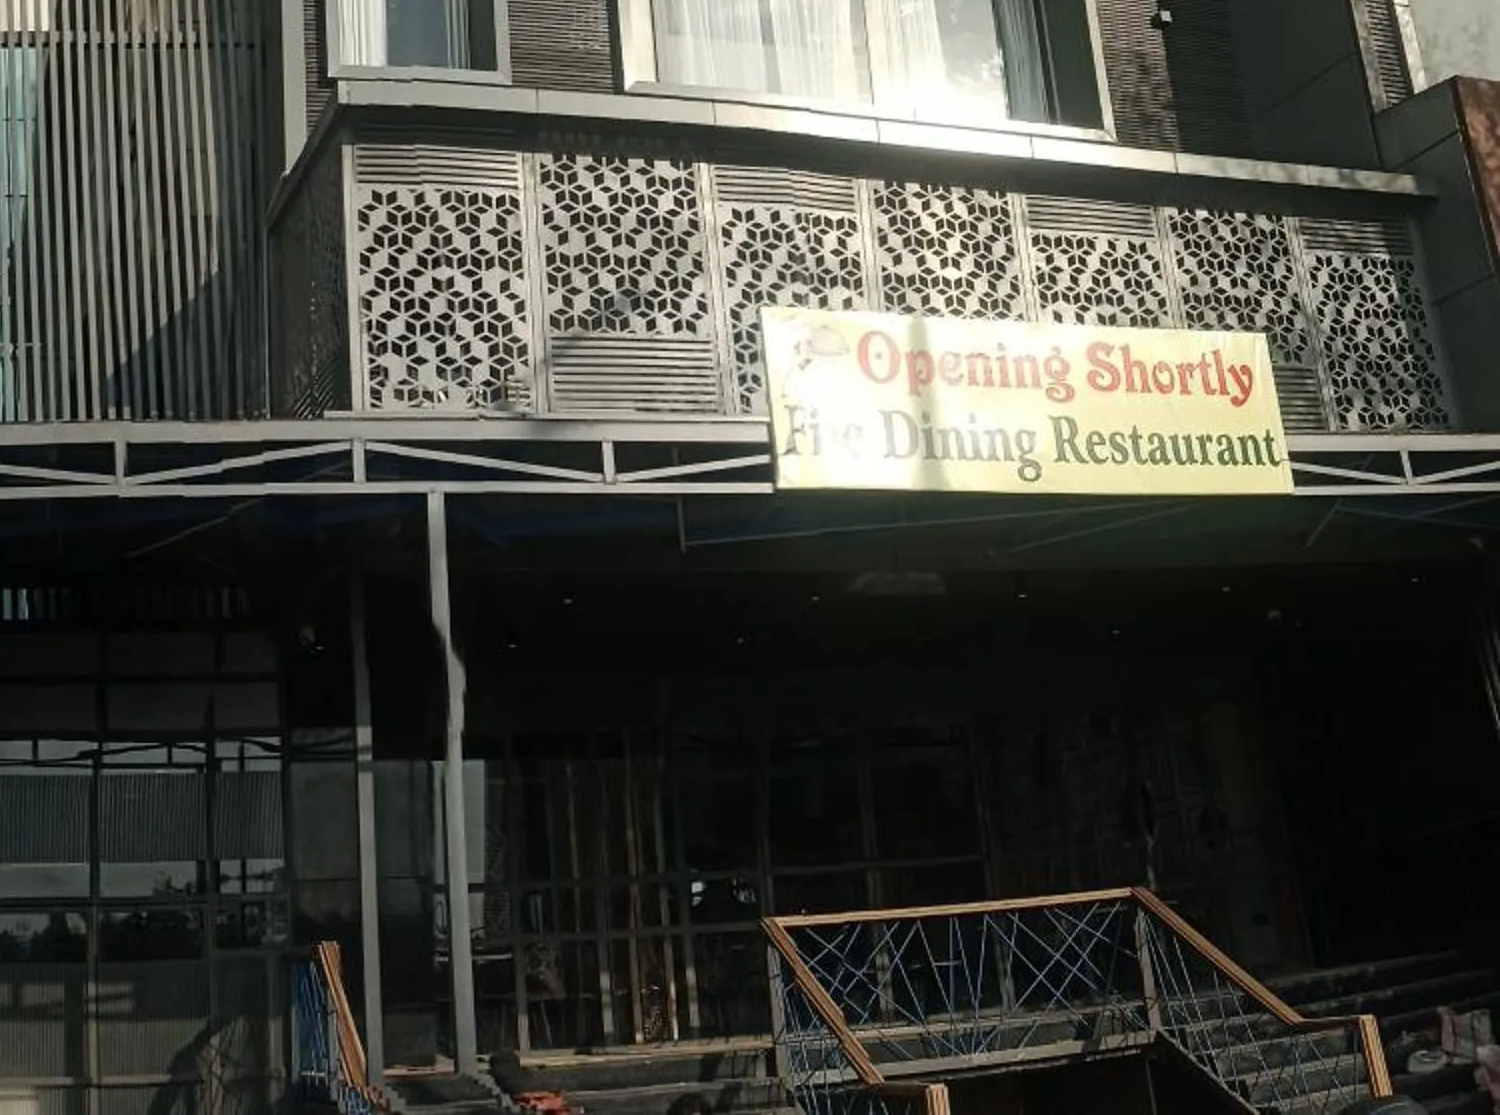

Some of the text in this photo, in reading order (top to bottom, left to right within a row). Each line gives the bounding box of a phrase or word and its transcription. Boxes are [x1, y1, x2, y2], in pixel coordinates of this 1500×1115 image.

[856, 329, 1254, 407] Opening Shortly
[877, 408, 1043, 483] Dining
[1049, 415, 1282, 467] Restaurant
